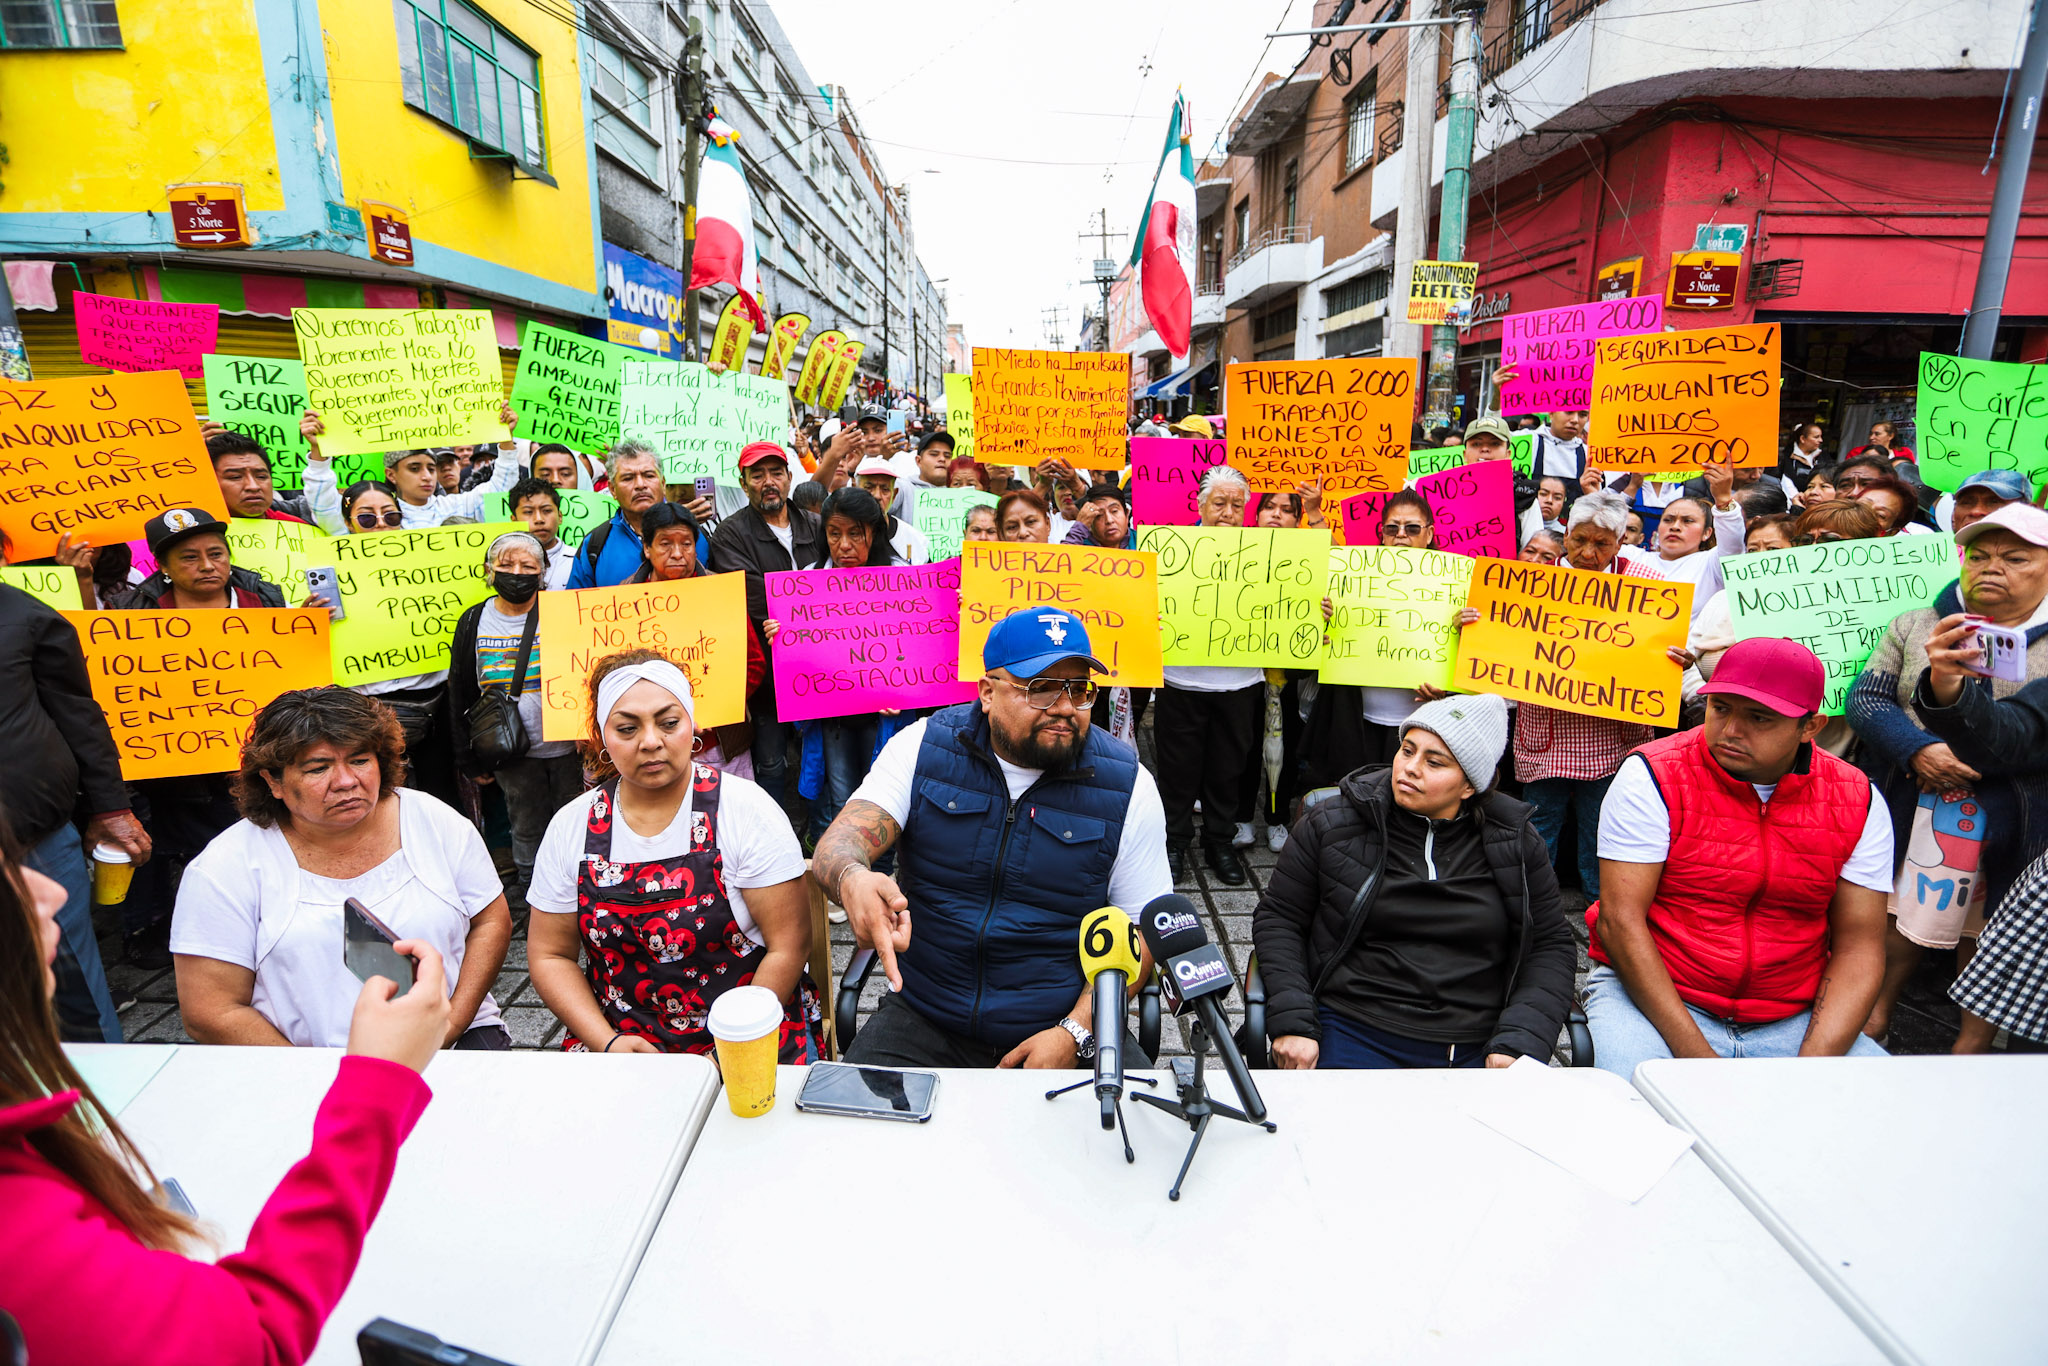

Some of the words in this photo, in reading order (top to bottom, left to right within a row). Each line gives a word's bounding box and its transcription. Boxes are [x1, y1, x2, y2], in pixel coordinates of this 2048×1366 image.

[189, 218, 196, 228] 5
[198, 217, 223, 229] Norte
[1706, 239, 1734, 250] NORTE
[1412, 264, 1476, 285] ECONÓMICOS
[1688, 281, 1695, 292] 5
[1697, 281, 1721, 292] Norte
[1411, 284, 1473, 300] FLETES
[83, 296, 216, 320] AMBULANTES
[1507, 310, 1585, 339] FUERZA
[1597, 300, 1658, 330] 2000
[88, 327, 203, 346] TRABAJAR
[100, 314, 207, 334] QUEREMOS
[294, 309, 404, 339] Queremos
[403, 310, 487, 343] Trabajar
[103, 340, 133, 353] EN
[151, 345, 191, 355] PAZ
[133, 355, 166, 365] SIN
[301, 338, 398, 368] Libremente
[402, 338, 442, 361] Mas
[448, 341, 475, 361] No
[531, 330, 605, 369] FUERZA
[225, 360, 290, 386] PAZ
[307, 368, 404, 390] Queremos
[411, 358, 481, 382] Muertes
[972, 348, 990, 367] El
[996, 348, 1041, 370] Miedo
[1046, 356, 1060, 371] ha
[1061, 351, 1128, 379] Impulsado
[1530, 363, 1593, 384] UNIDO
[528, 361, 621, 396] AMBULAN
[622, 361, 701, 388] Libertad
[705, 369, 726, 391] De
[726, 369, 782, 408] Trabajar
[975, 371, 986, 393] A
[991, 372, 1051, 397] Grandes
[1055, 374, 1127, 403] Movimientos
[1237, 369, 1333, 396] FUERZA
[1346, 368, 1410, 397] 2000
[1601, 370, 1770, 405] AMBULANTES
[219, 390, 307, 416] SEGUR
[309, 387, 417, 415] Gobernantes
[423, 388, 432, 408] y
[432, 374, 504, 400] Comerciantes
[549, 385, 620, 417] GENTE
[1504, 392, 1527, 408] POR
[1533, 391, 1550, 407] LA
[342, 405, 428, 426] Queremos
[431, 402, 448, 415] un
[453, 397, 503, 414] Centro
[517, 398, 620, 435] TRABAJA
[622, 401, 697, 427] Libertad
[708, 409, 728, 428] de
[735, 407, 781, 442] Vivir
[974, 396, 983, 412] A
[983, 396, 1032, 418] Luchar
[1037, 405, 1061, 422] por
[1064, 407, 1087, 418] sus
[1252, 400, 1368, 423] TRABAJO
[1618, 408, 1719, 433] UNIDOS
[0, 418, 183, 450] NQUILIDAD
[222, 421, 286, 446] PARA
[655, 429, 709, 452] Temor
[714, 440, 733, 452] en
[979, 415, 1029, 435] Trabajos
[1044, 422, 1076, 439] Esta
[1080, 419, 1127, 439] multitud
[1242, 425, 1363, 444] HONESTO
[1930, 405, 1967, 440] En
[1986, 418, 2018, 451] El
[74, 447, 142, 470] LOS
[1024, 439, 1085, 457] Queremos
[1192, 443, 1226, 467] NO
[1235, 446, 1328, 460] ALZANDO
[1341, 445, 1366, 458] LA
[1372, 444, 1407, 460] VOZ
[1589, 445, 1656, 465] FUERZA
[1670, 438, 1749, 465] 2000
[1926, 435, 1963, 467] De
[662, 454, 709, 474] Todo
[1137, 464, 1150, 481] A
[1156, 466, 1184, 484] LA
[1252, 460, 1378, 475] SEGURIDAD
[1409, 453, 1464, 475] UERZA
[1308, 474, 1390, 492] TODOS
[919, 491, 955, 509] AQUI
[30, 493, 193, 536] GENERAL
[331, 530, 485, 561] RESPETO
[1810, 545, 1886, 574] 2000
[1924, 539, 1949, 566] UN
[968, 547, 1072, 575] FUERZA
[1082, 553, 1145, 578] 2000
[1328, 547, 1413, 575] SOMOS
[24, 571, 63, 594] NO
[771, 575, 814, 598] LOS
[826, 566, 961, 592] AMBULANTES
[1001, 577, 1083, 603] PIDE
[1327, 574, 1409, 601] ANTES
[1413, 588, 1445, 602] DE
[1483, 563, 1680, 620] AMBULANTES
[1737, 573, 1928, 616] MOVIMIENTO
[376, 591, 463, 619] PARA
[575, 588, 680, 625] Federico
[791, 596, 933, 623] MERECEMOS
[1193, 583, 1220, 618] El
[1236, 584, 1311, 622] Centro
[89, 616, 192, 645] ALTO
[222, 616, 250, 635] A
[272, 615, 318, 636] LA
[411, 613, 458, 637] LOS
[593, 624, 625, 648] NO
[638, 615, 668, 645] Es
[1325, 605, 1349, 632] NO
[1351, 607, 1392, 629] DE
[1490, 600, 1635, 648] HONESTOS
[1815, 609, 1865, 628] DE
[1208, 618, 1280, 657] Puebla
[1327, 639, 1360, 659] NI
[1377, 635, 1448, 662] Armas
[85, 647, 283, 676] IOLENCIA
[344, 641, 452, 675] AMBULA
[1534, 641, 1576, 671] NO
[114, 681, 162, 704] EN
[191, 678, 245, 698] EL
[544, 675, 579, 711] Es
[1468, 657, 1665, 718] DELINCUENTES
[1916, 871, 1971, 912] Mi
[1154, 911, 1196, 931] Quinto
[1084, 914, 1115, 958] 6
[1128, 921, 1142, 963] 6
[1175, 959, 1224, 981] Quinto
